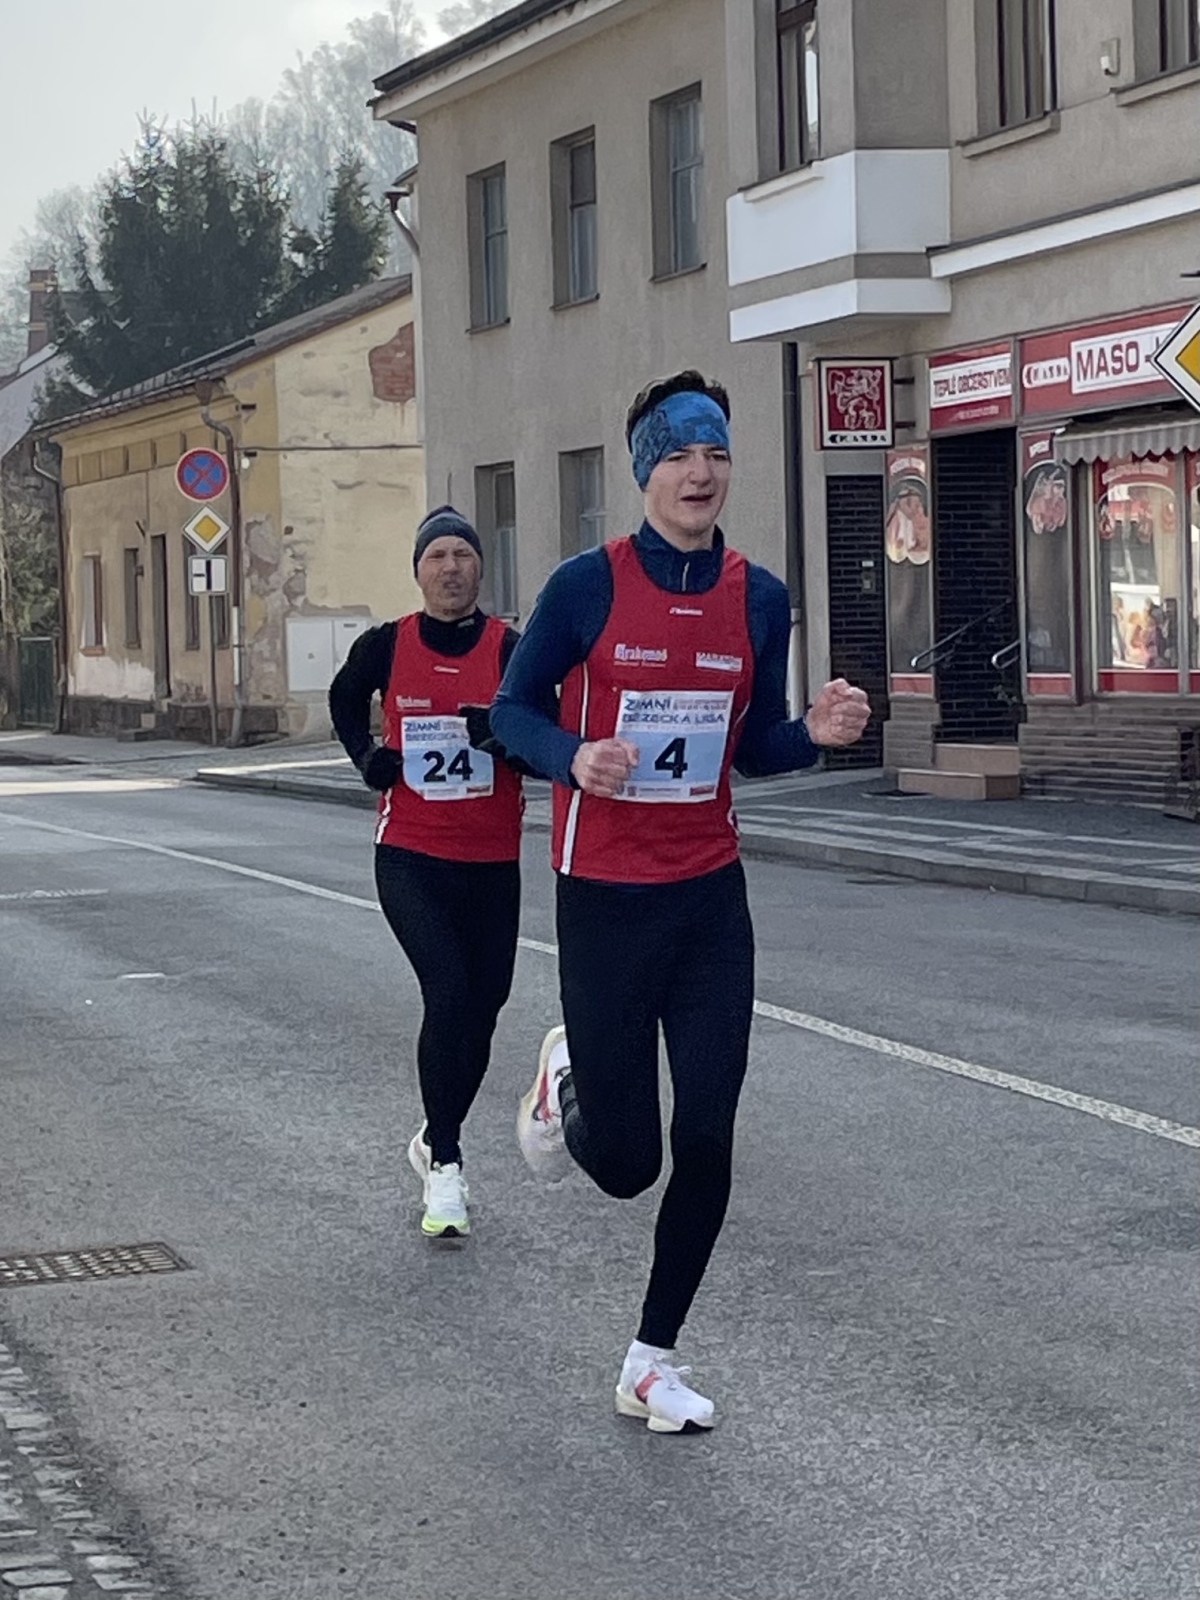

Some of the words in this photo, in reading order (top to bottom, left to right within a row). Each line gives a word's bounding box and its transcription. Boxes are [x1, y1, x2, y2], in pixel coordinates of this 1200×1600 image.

[1076, 340, 1140, 382] MASO
[423, 750, 474, 783] 24
[654, 737, 688, 780] 4
